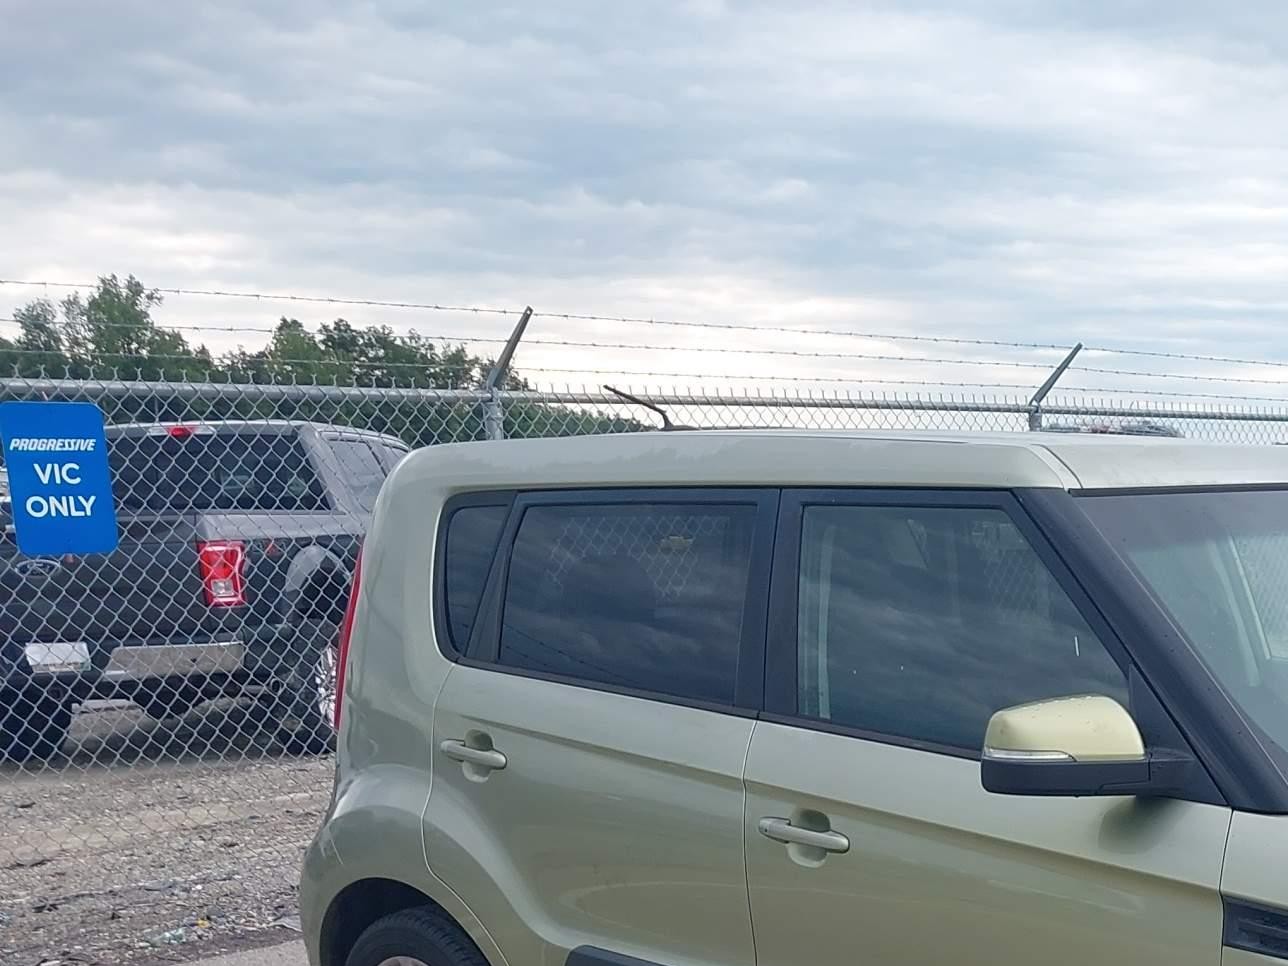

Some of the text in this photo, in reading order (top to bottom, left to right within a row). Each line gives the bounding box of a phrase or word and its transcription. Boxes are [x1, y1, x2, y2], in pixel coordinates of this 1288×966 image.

[9, 438, 97, 452] PROGRESSIVE
[32, 462, 82, 485] VIC
[25, 495, 97, 518] ONLY
